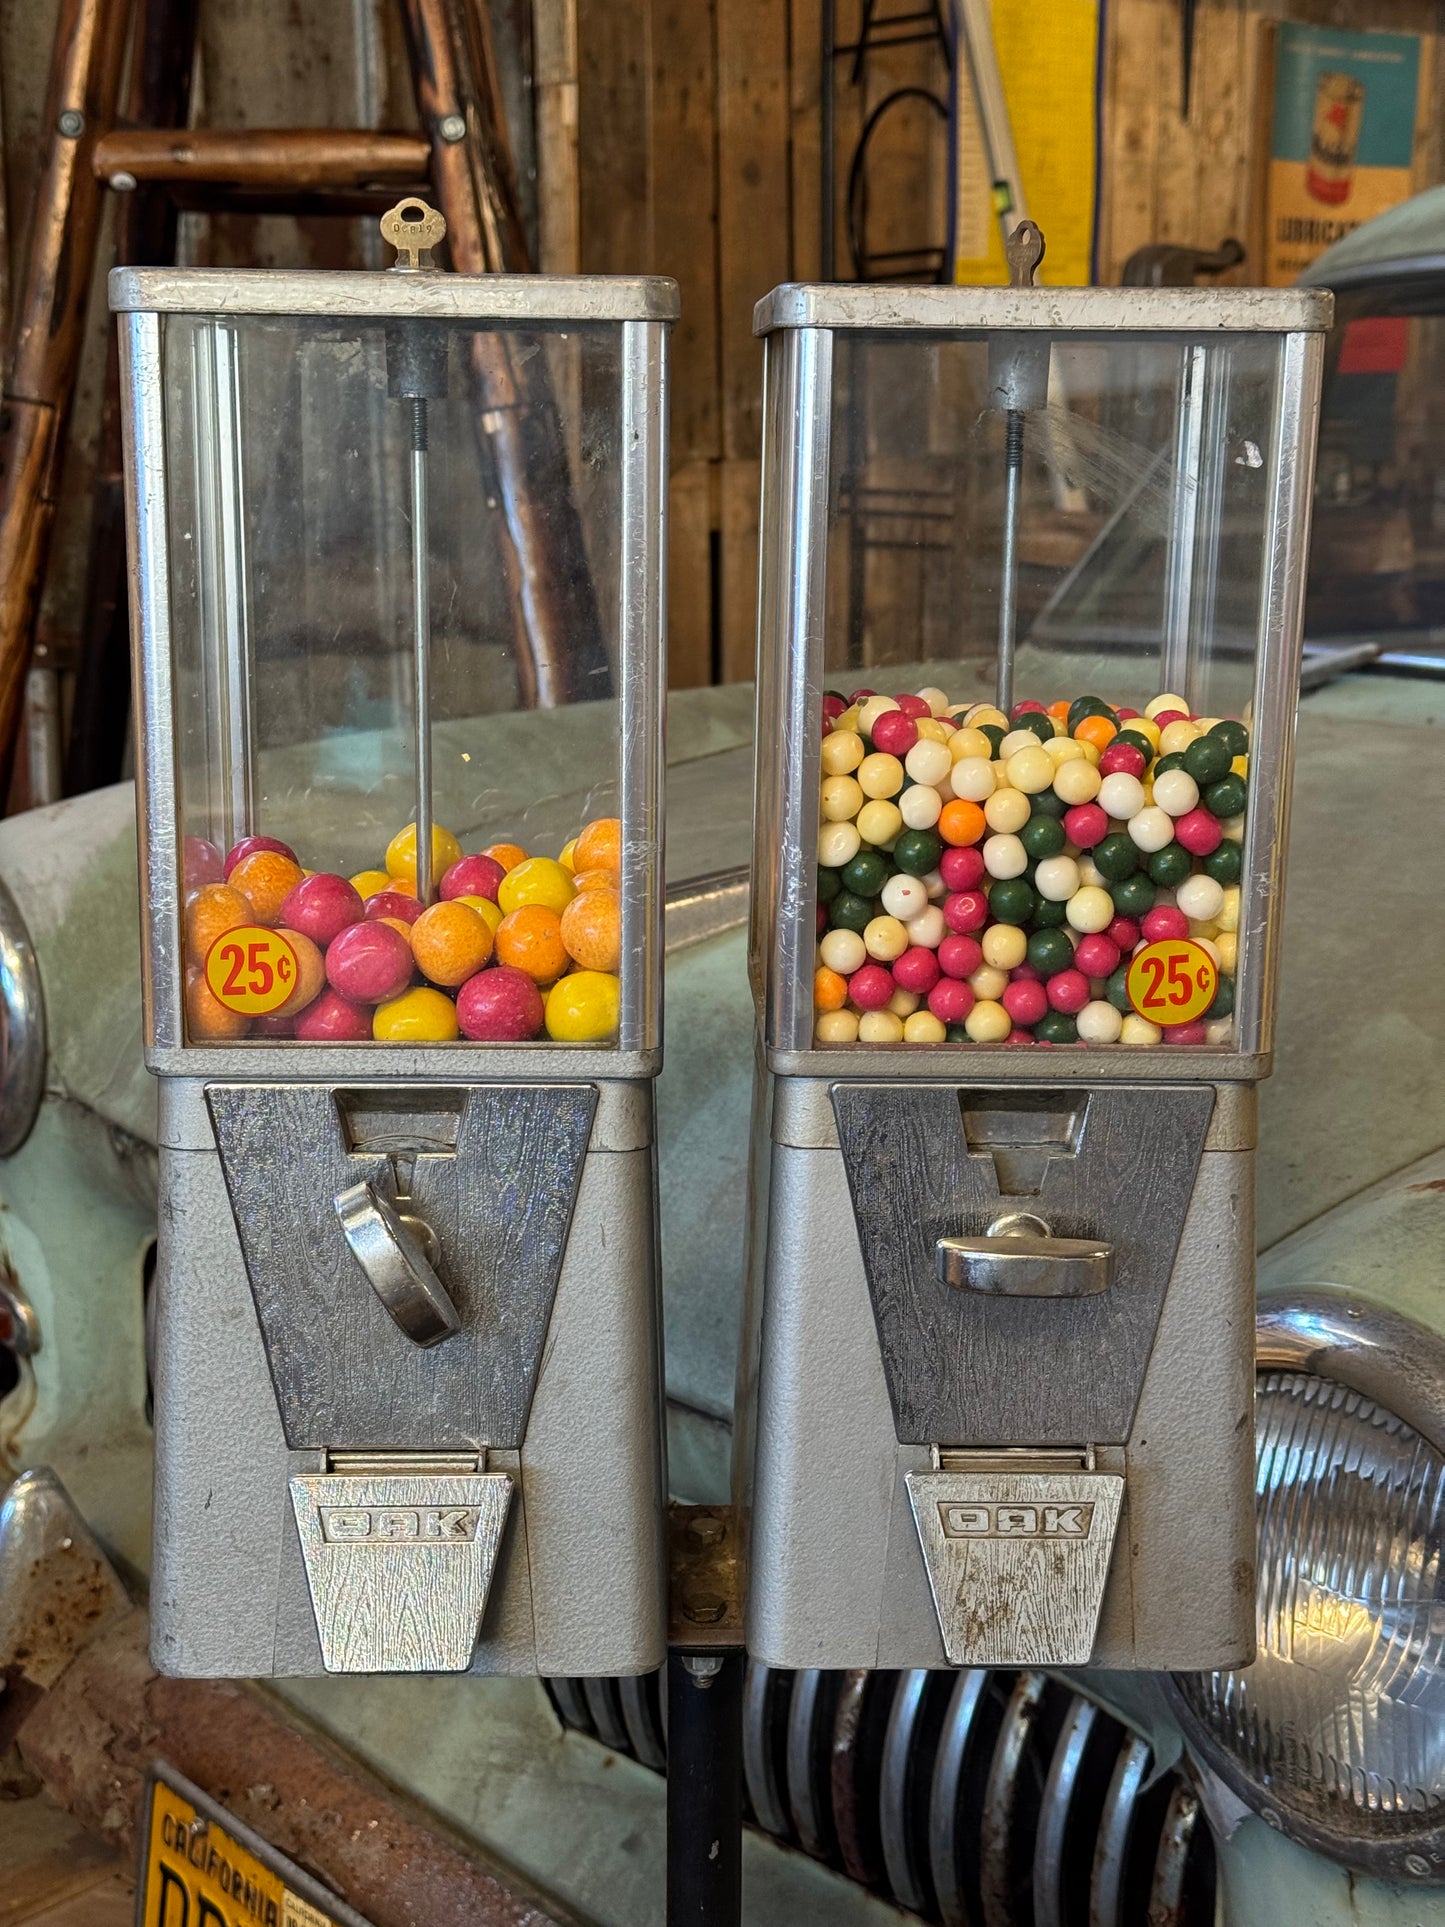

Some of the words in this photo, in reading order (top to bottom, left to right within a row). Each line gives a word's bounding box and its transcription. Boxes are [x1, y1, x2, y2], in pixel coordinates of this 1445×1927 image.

[220, 943, 291, 996] 25¢
[1141, 954, 1210, 1008] 25¢
[328, 1510, 469, 1538] OAK
[948, 1507, 1083, 1533] OAK
[163, 1812, 281, 1925] CALIFORNIA
